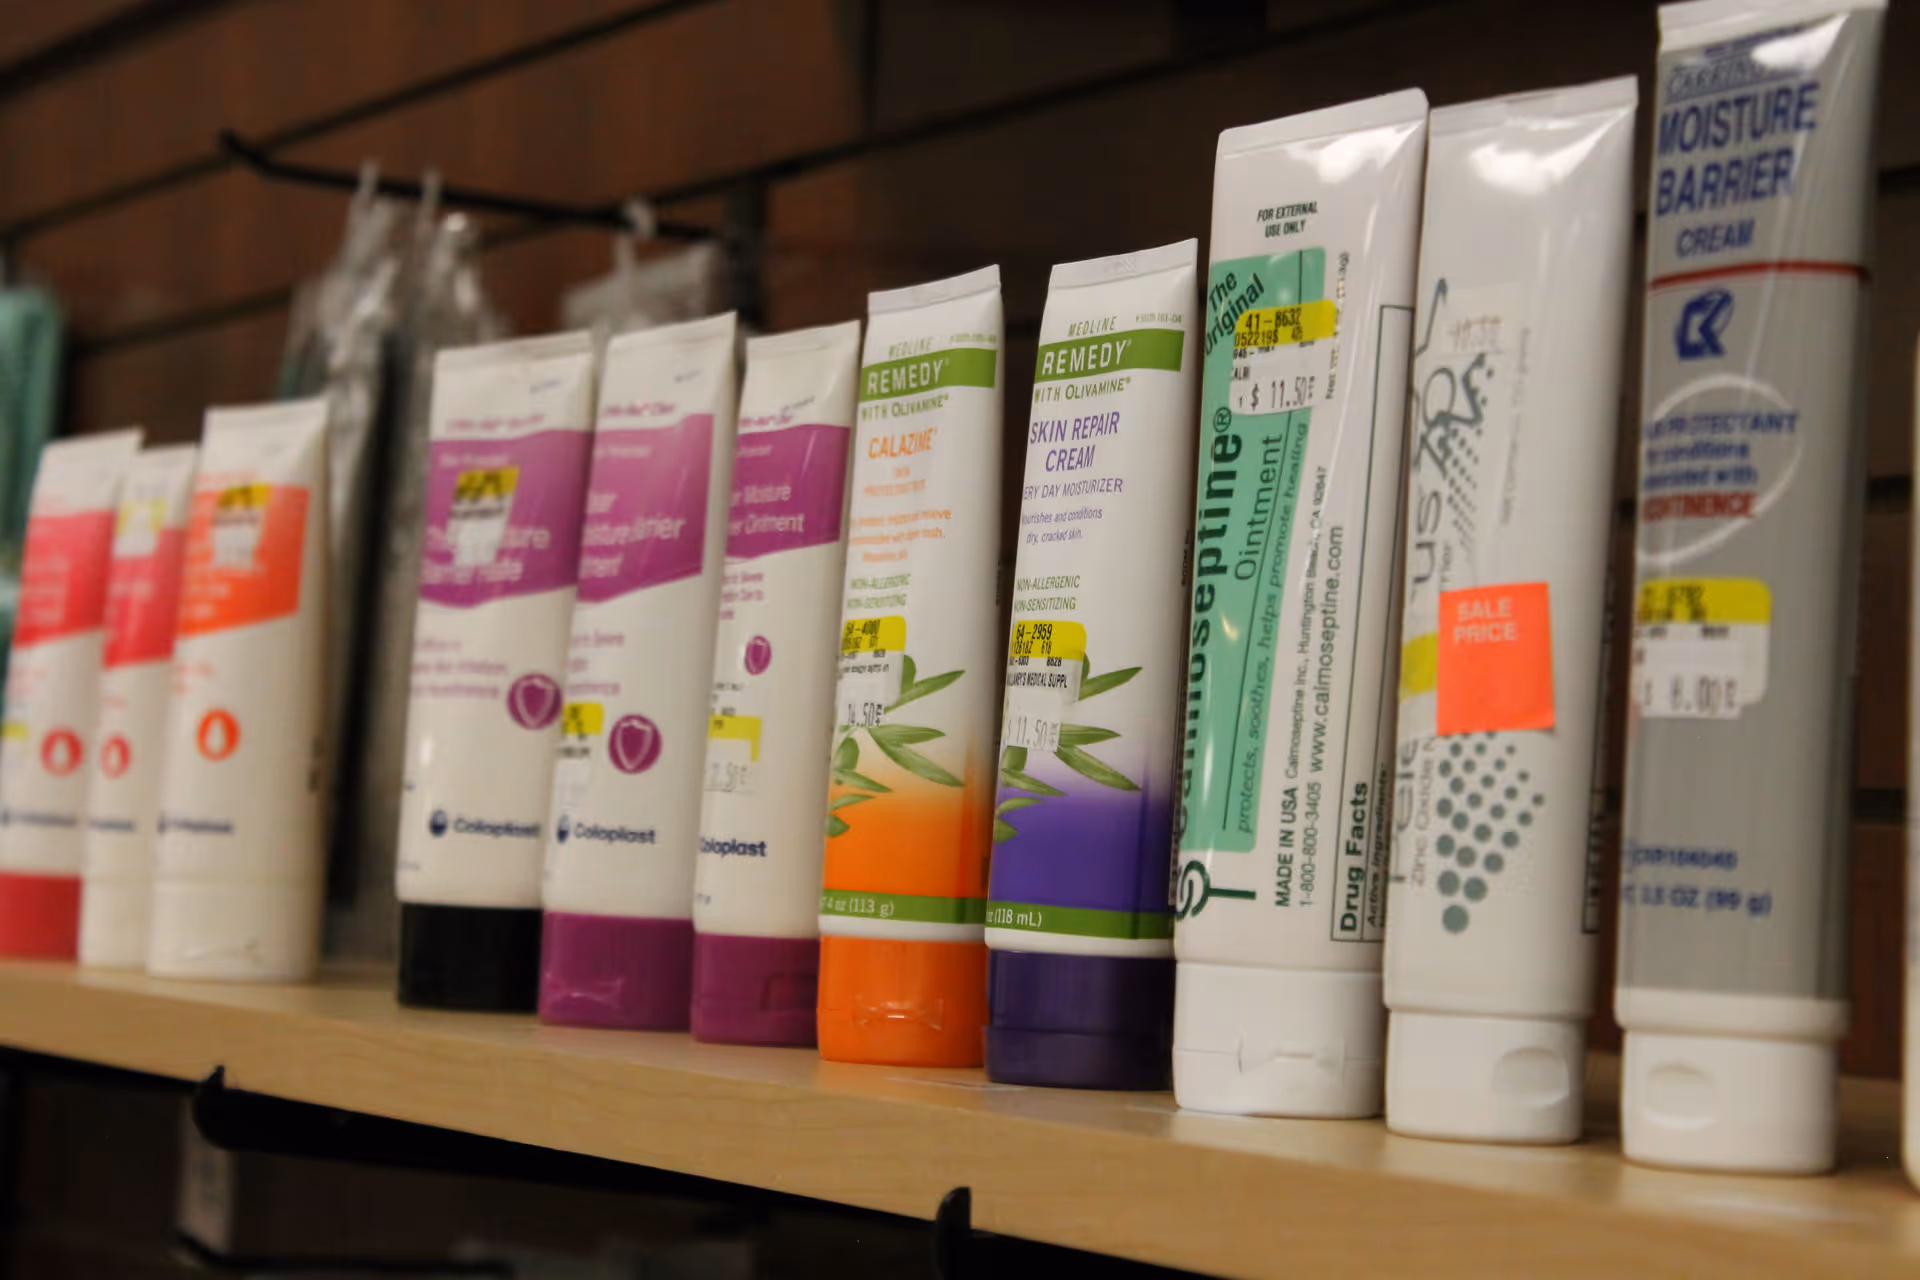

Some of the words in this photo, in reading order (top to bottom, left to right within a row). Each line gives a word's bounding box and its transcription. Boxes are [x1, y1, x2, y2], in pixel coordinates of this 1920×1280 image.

[1658, 81, 1820, 156] MOISTURE
[1655, 149, 1795, 217] BARRIER
[1257, 208, 1274, 222] FOR
[1276, 201, 1318, 219] EXTERNAL
[1265, 223, 1281, 238] USE
[1284, 219, 1306, 235] ONLY
[1676, 219, 1755, 258] CREAM
[1209, 272, 1237, 312] The
[1067, 316, 1118, 337] MEDLINE
[866, 359, 944, 395] REMEDY
[1041, 340, 1127, 376] REMEDY
[1030, 419, 1068, 444] SKIN
[1071, 411, 1121, 441] REPAIR
[1045, 444, 1096, 473] CREAM
[1283, 422, 1308, 500] healing
[1041, 484, 1061, 498] DAY
[1062, 477, 1124, 498] MOISTURIZER
[1054, 510, 1067, 523] and
[1068, 506, 1103, 522] conditions
[1234, 433, 1284, 582] Ointment
[1270, 503, 1291, 588] promote
[1016, 575, 1081, 593] NON-ALLERGENIC
[1258, 594, 1279, 648] helps
[1296, 576, 1316, 655] Huntington
[1456, 597, 1513, 622] SALE
[1309, 525, 1344, 773] www.calmoseptine.com
[1453, 621, 1518, 645] PRICE
[1249, 657, 1270, 741] soothes,
[1286, 690, 1305, 779] Calmoseptine
[1238, 746, 1259, 835] protects,
[1281, 786, 1298, 825] USA
[453, 817, 542, 838] Coloplast
[573, 821, 656, 844] Coloplast
[1279, 829, 1295, 848] IN
[1345, 782, 1369, 856] Facts
[1299, 781, 1322, 907] 1-800-800-3405
[1275, 852, 1293, 907] MADE
[849, 898, 875, 915] (113
[879, 900, 895, 917] g)
[1339, 866, 1366, 933] Drug
[1016, 911, 1043, 929] mL)
